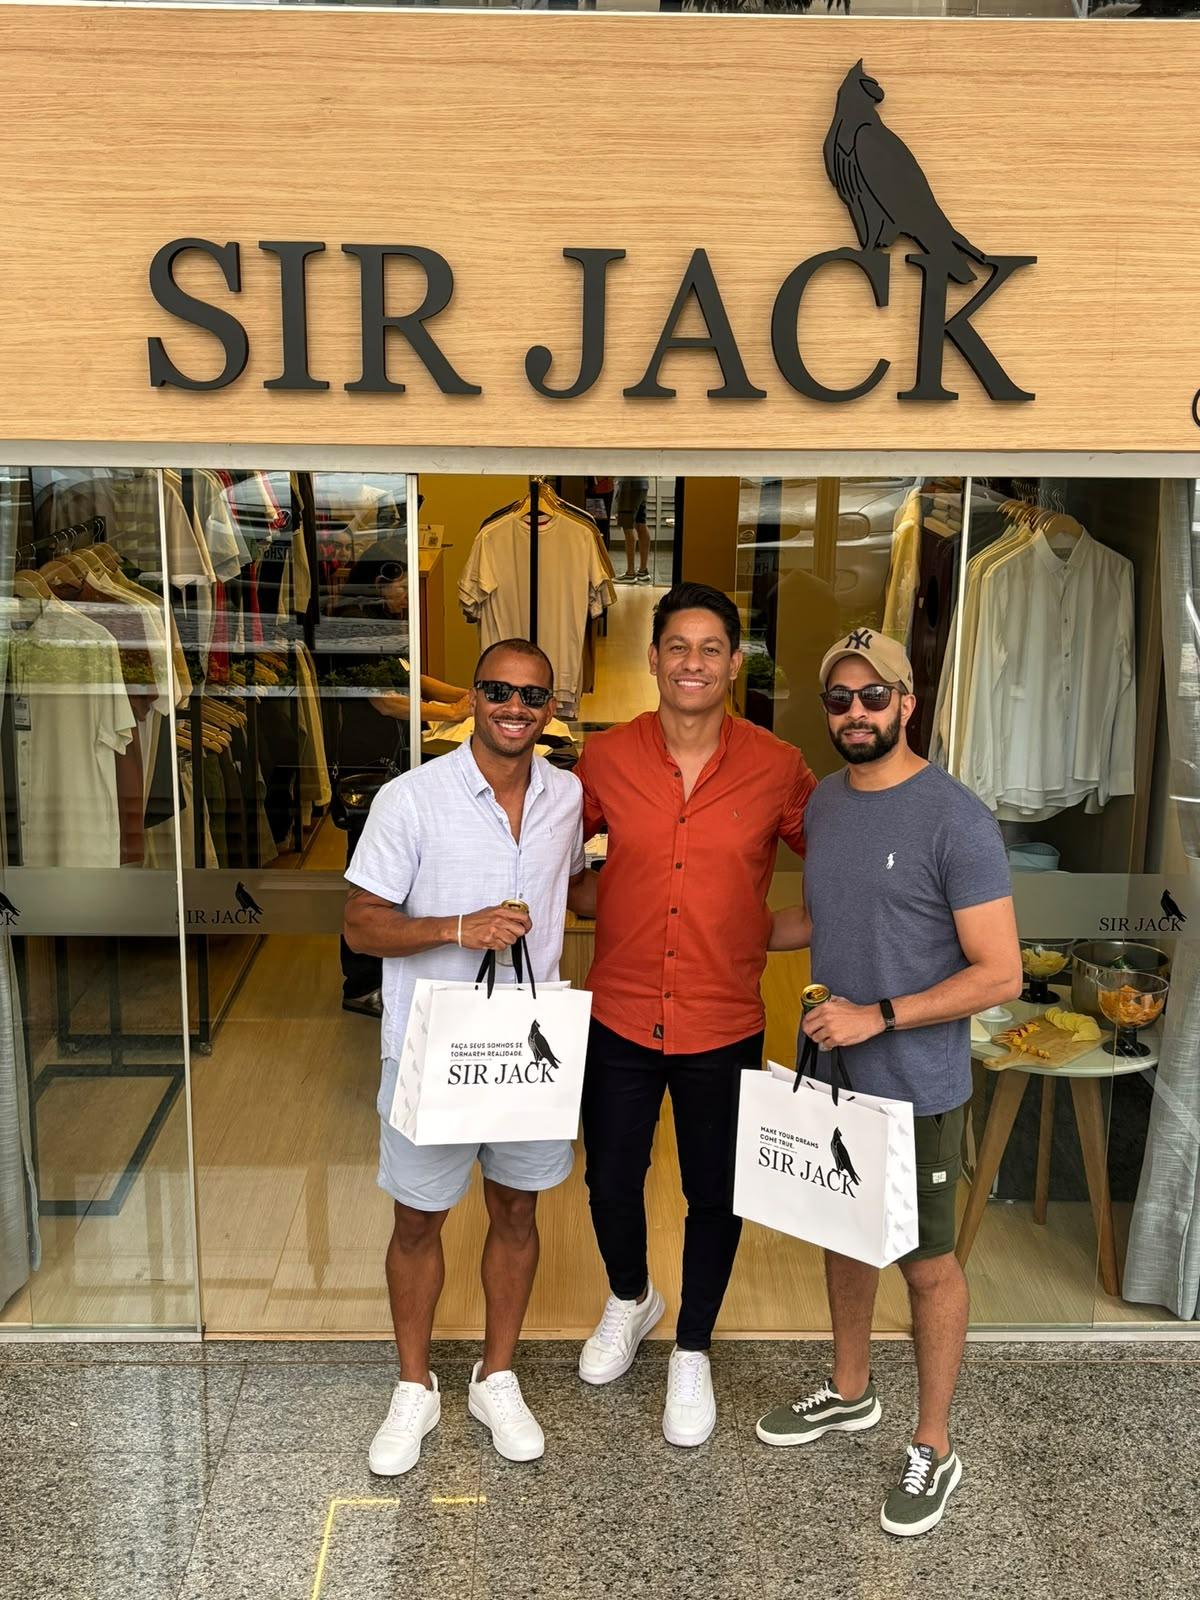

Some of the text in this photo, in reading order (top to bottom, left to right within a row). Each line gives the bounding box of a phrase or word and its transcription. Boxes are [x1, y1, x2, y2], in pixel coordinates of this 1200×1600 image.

[148, 237, 1037, 403] SIR JACK
[211, 909, 260, 924] JACK
[1098, 916, 1183, 932] SIR JACK
[451, 1042, 468, 1050] FAÇA
[447, 1061, 555, 1085] SIR JACK
[760, 1126, 777, 1135] MAKE
[778, 1131, 795, 1141] YOUR
[795, 1136, 819, 1149] DREAMS
[760, 1134, 777, 1143] COME
[758, 1146, 796, 1176] SIR
[800, 1160, 856, 1198] JACK
